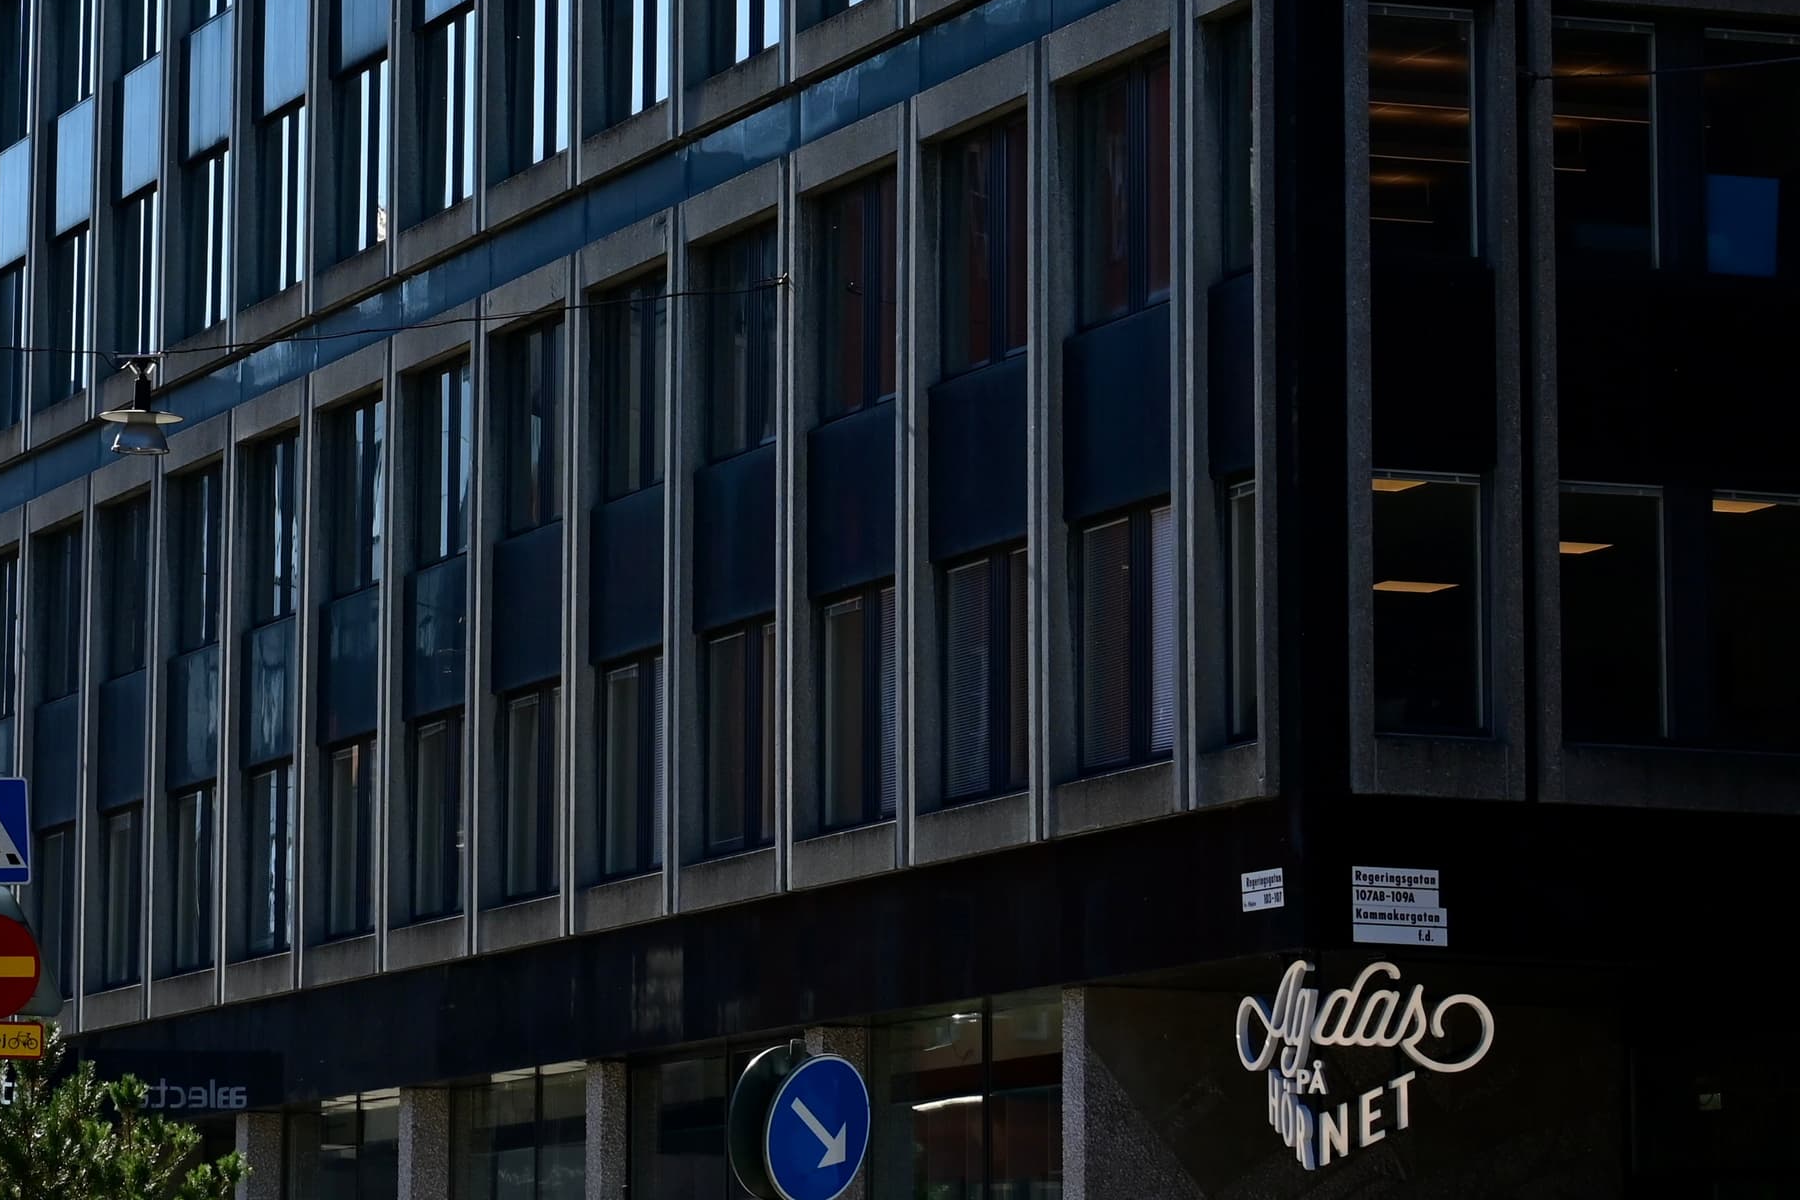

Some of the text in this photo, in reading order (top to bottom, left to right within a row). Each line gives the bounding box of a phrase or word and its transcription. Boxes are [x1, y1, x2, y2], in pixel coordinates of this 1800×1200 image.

[1355, 870, 1436, 887] Regeringsgatan
[1355, 889, 1415, 903] 107AB-109A
[1355, 907, 1440, 924] Kammakargatan
[1418, 929, 1434, 942] f.d.
[1297, 1060, 1328, 1095] PÅ
[1268, 1068, 1416, 1171] HÖRNET
